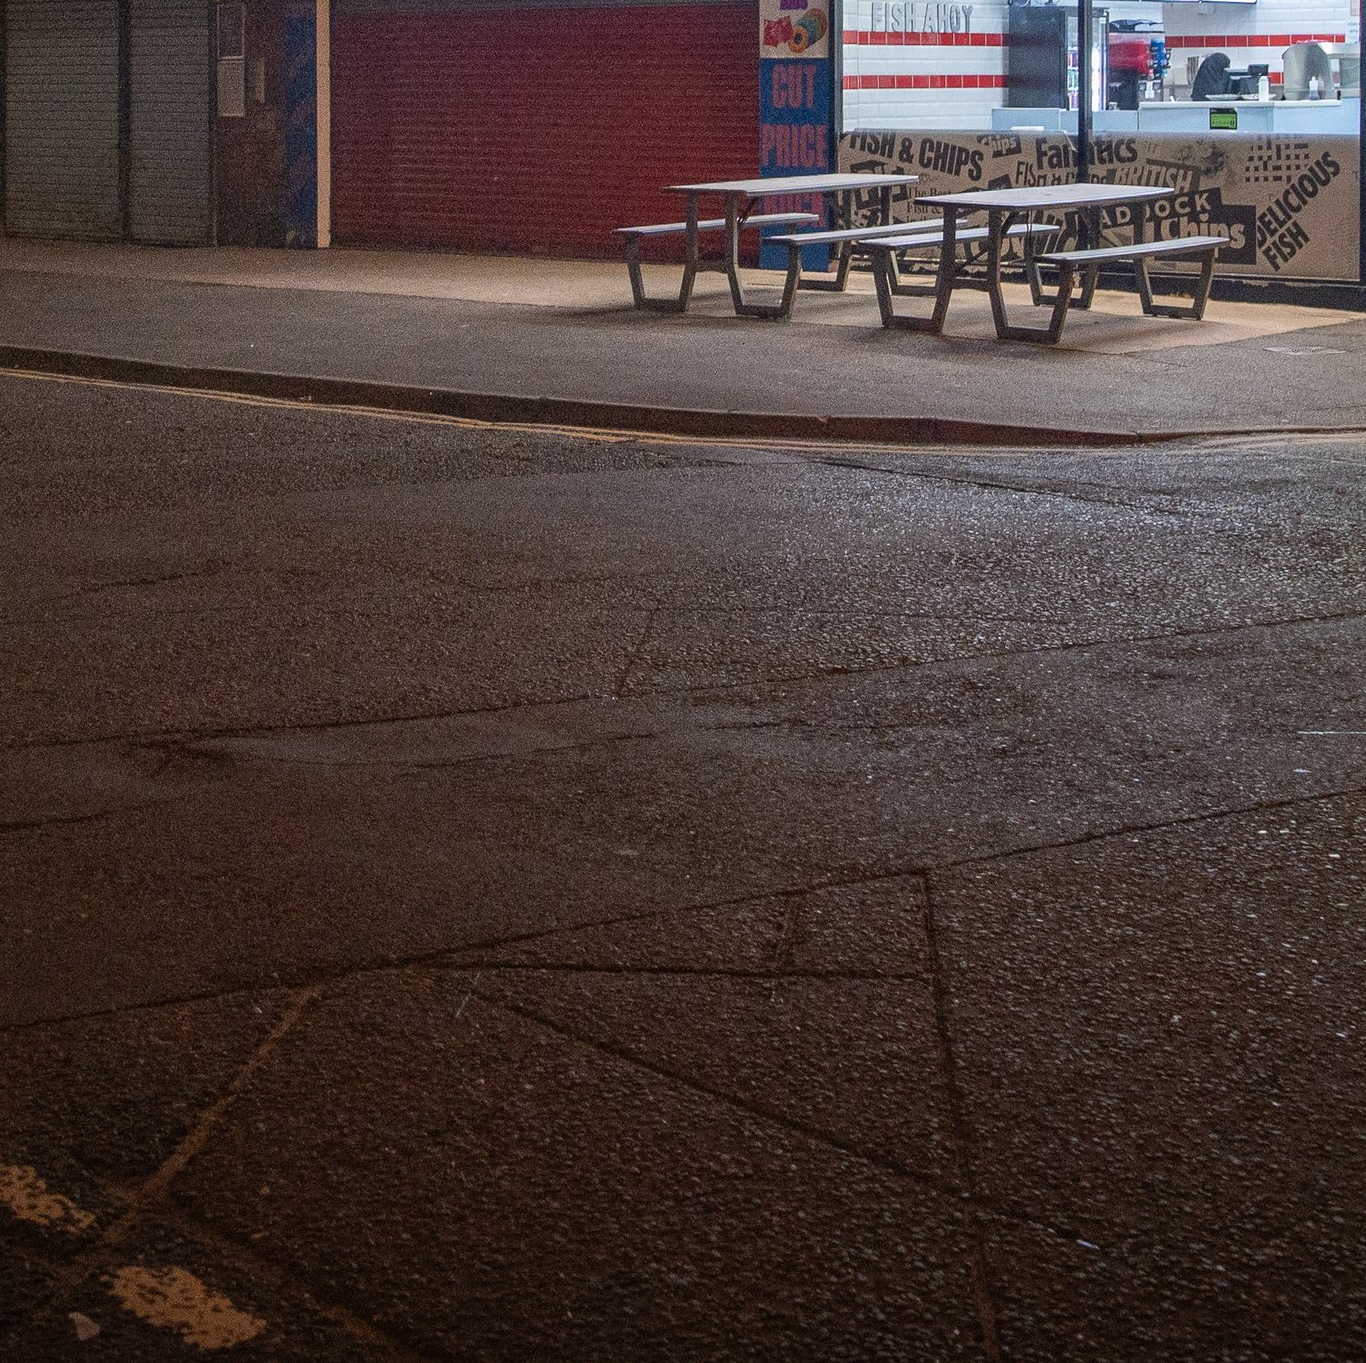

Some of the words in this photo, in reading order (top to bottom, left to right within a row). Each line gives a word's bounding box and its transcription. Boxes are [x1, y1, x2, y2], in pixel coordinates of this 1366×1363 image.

[871, 2, 915, 33] FISH
[922, 2, 974, 34] AHOY
[771, 63, 817, 110] CUT
[761, 123, 828, 169] PRICE
[897, 136, 914, 164] &
[918, 136, 984, 182] CHIPS
[1114, 162, 1193, 195] BRITISH
[1261, 219, 1311, 272] FISH
